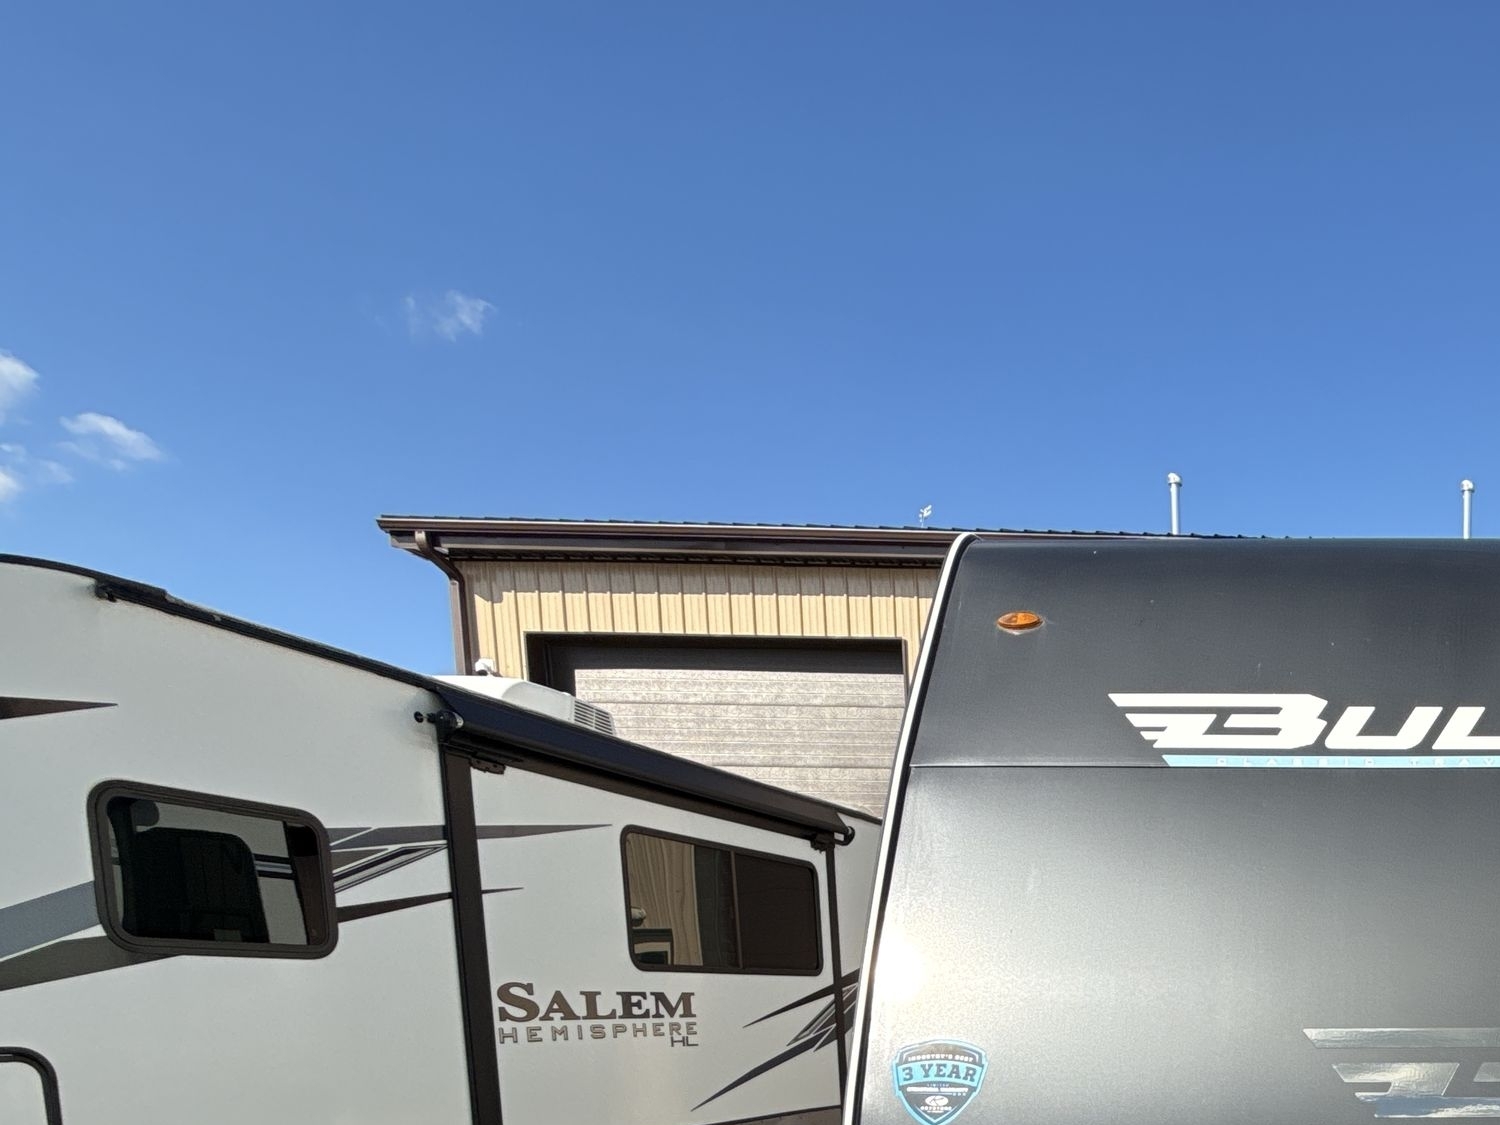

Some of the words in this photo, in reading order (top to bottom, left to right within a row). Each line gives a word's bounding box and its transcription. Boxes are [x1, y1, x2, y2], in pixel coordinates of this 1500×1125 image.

[497, 982, 697, 1022] SALEM
[498, 1021, 698, 1045] HEMISPHERE
[671, 1036, 699, 1047] HL
[902, 1066, 914, 1081] 3
[920, 1063, 978, 1083] YEAR
